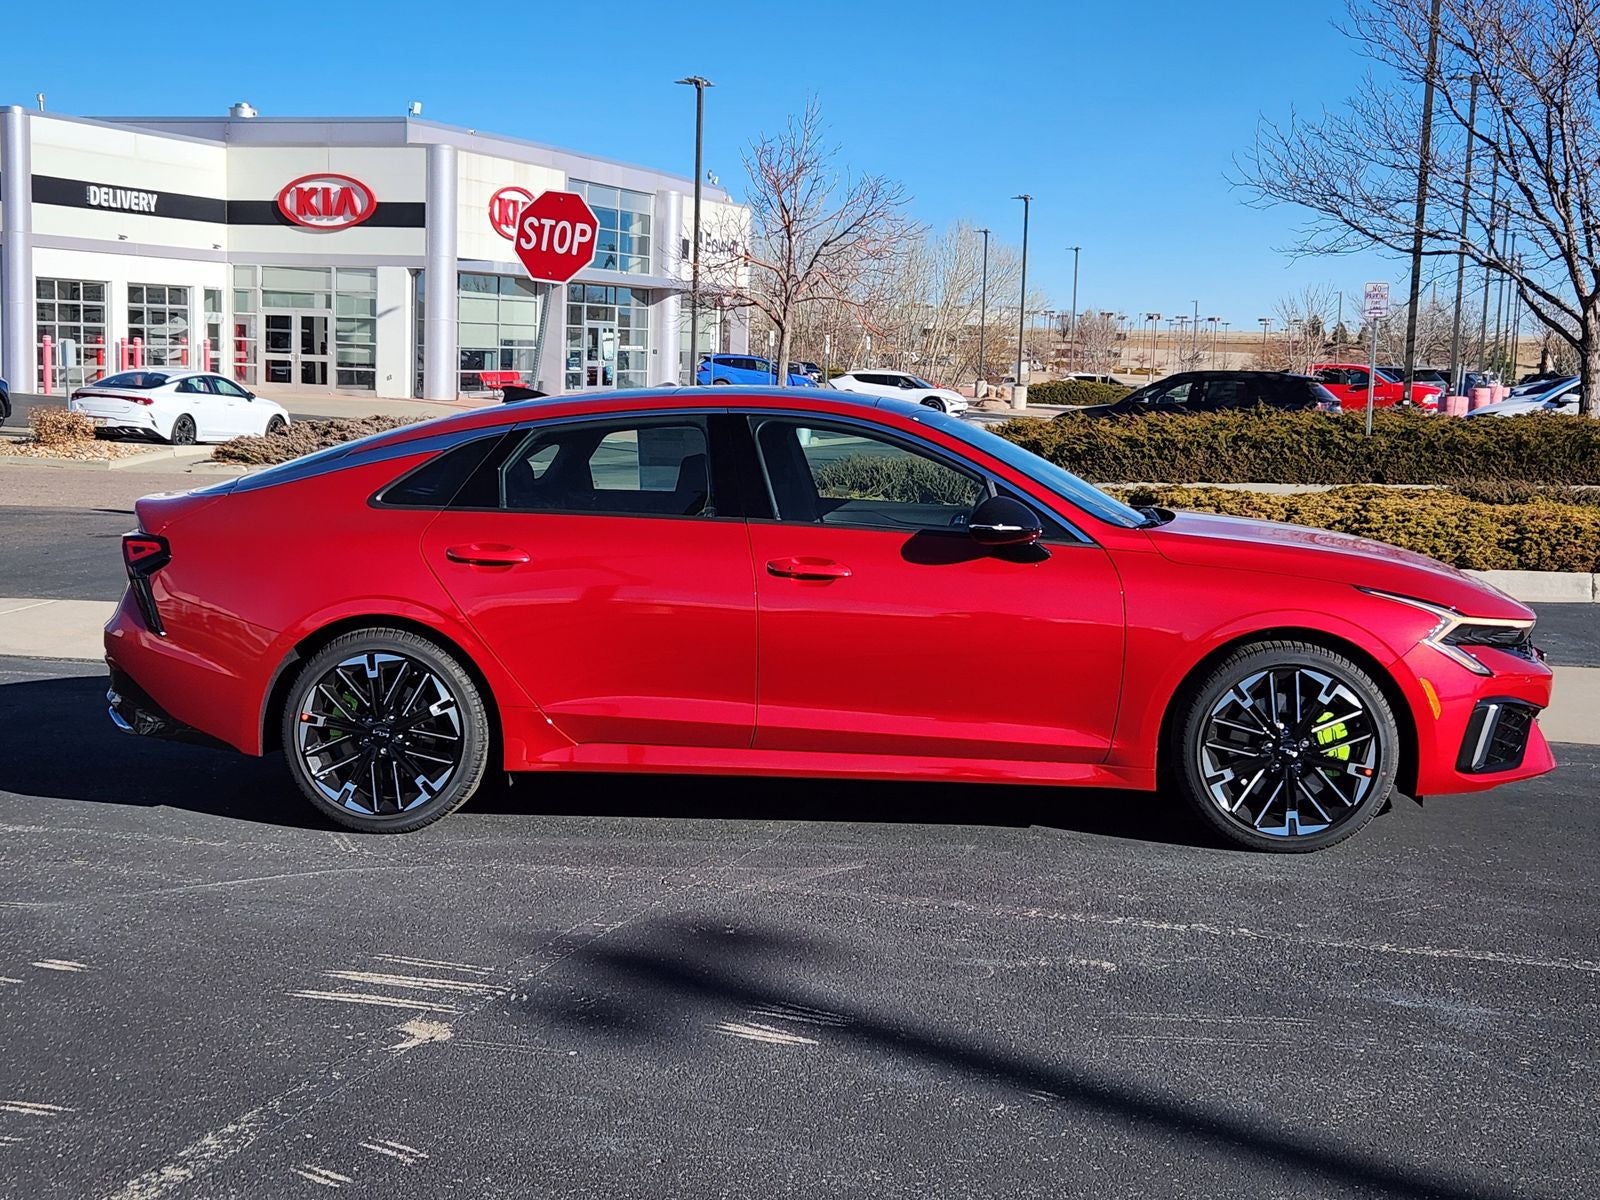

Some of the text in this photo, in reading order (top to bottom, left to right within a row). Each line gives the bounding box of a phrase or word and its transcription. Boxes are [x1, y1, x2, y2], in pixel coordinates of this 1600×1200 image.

[87, 185, 158, 212] DELIVERY
[294, 187, 359, 217] KIA
[520, 216, 592, 256] STOP
[1372, 285, 1382, 293] NO
